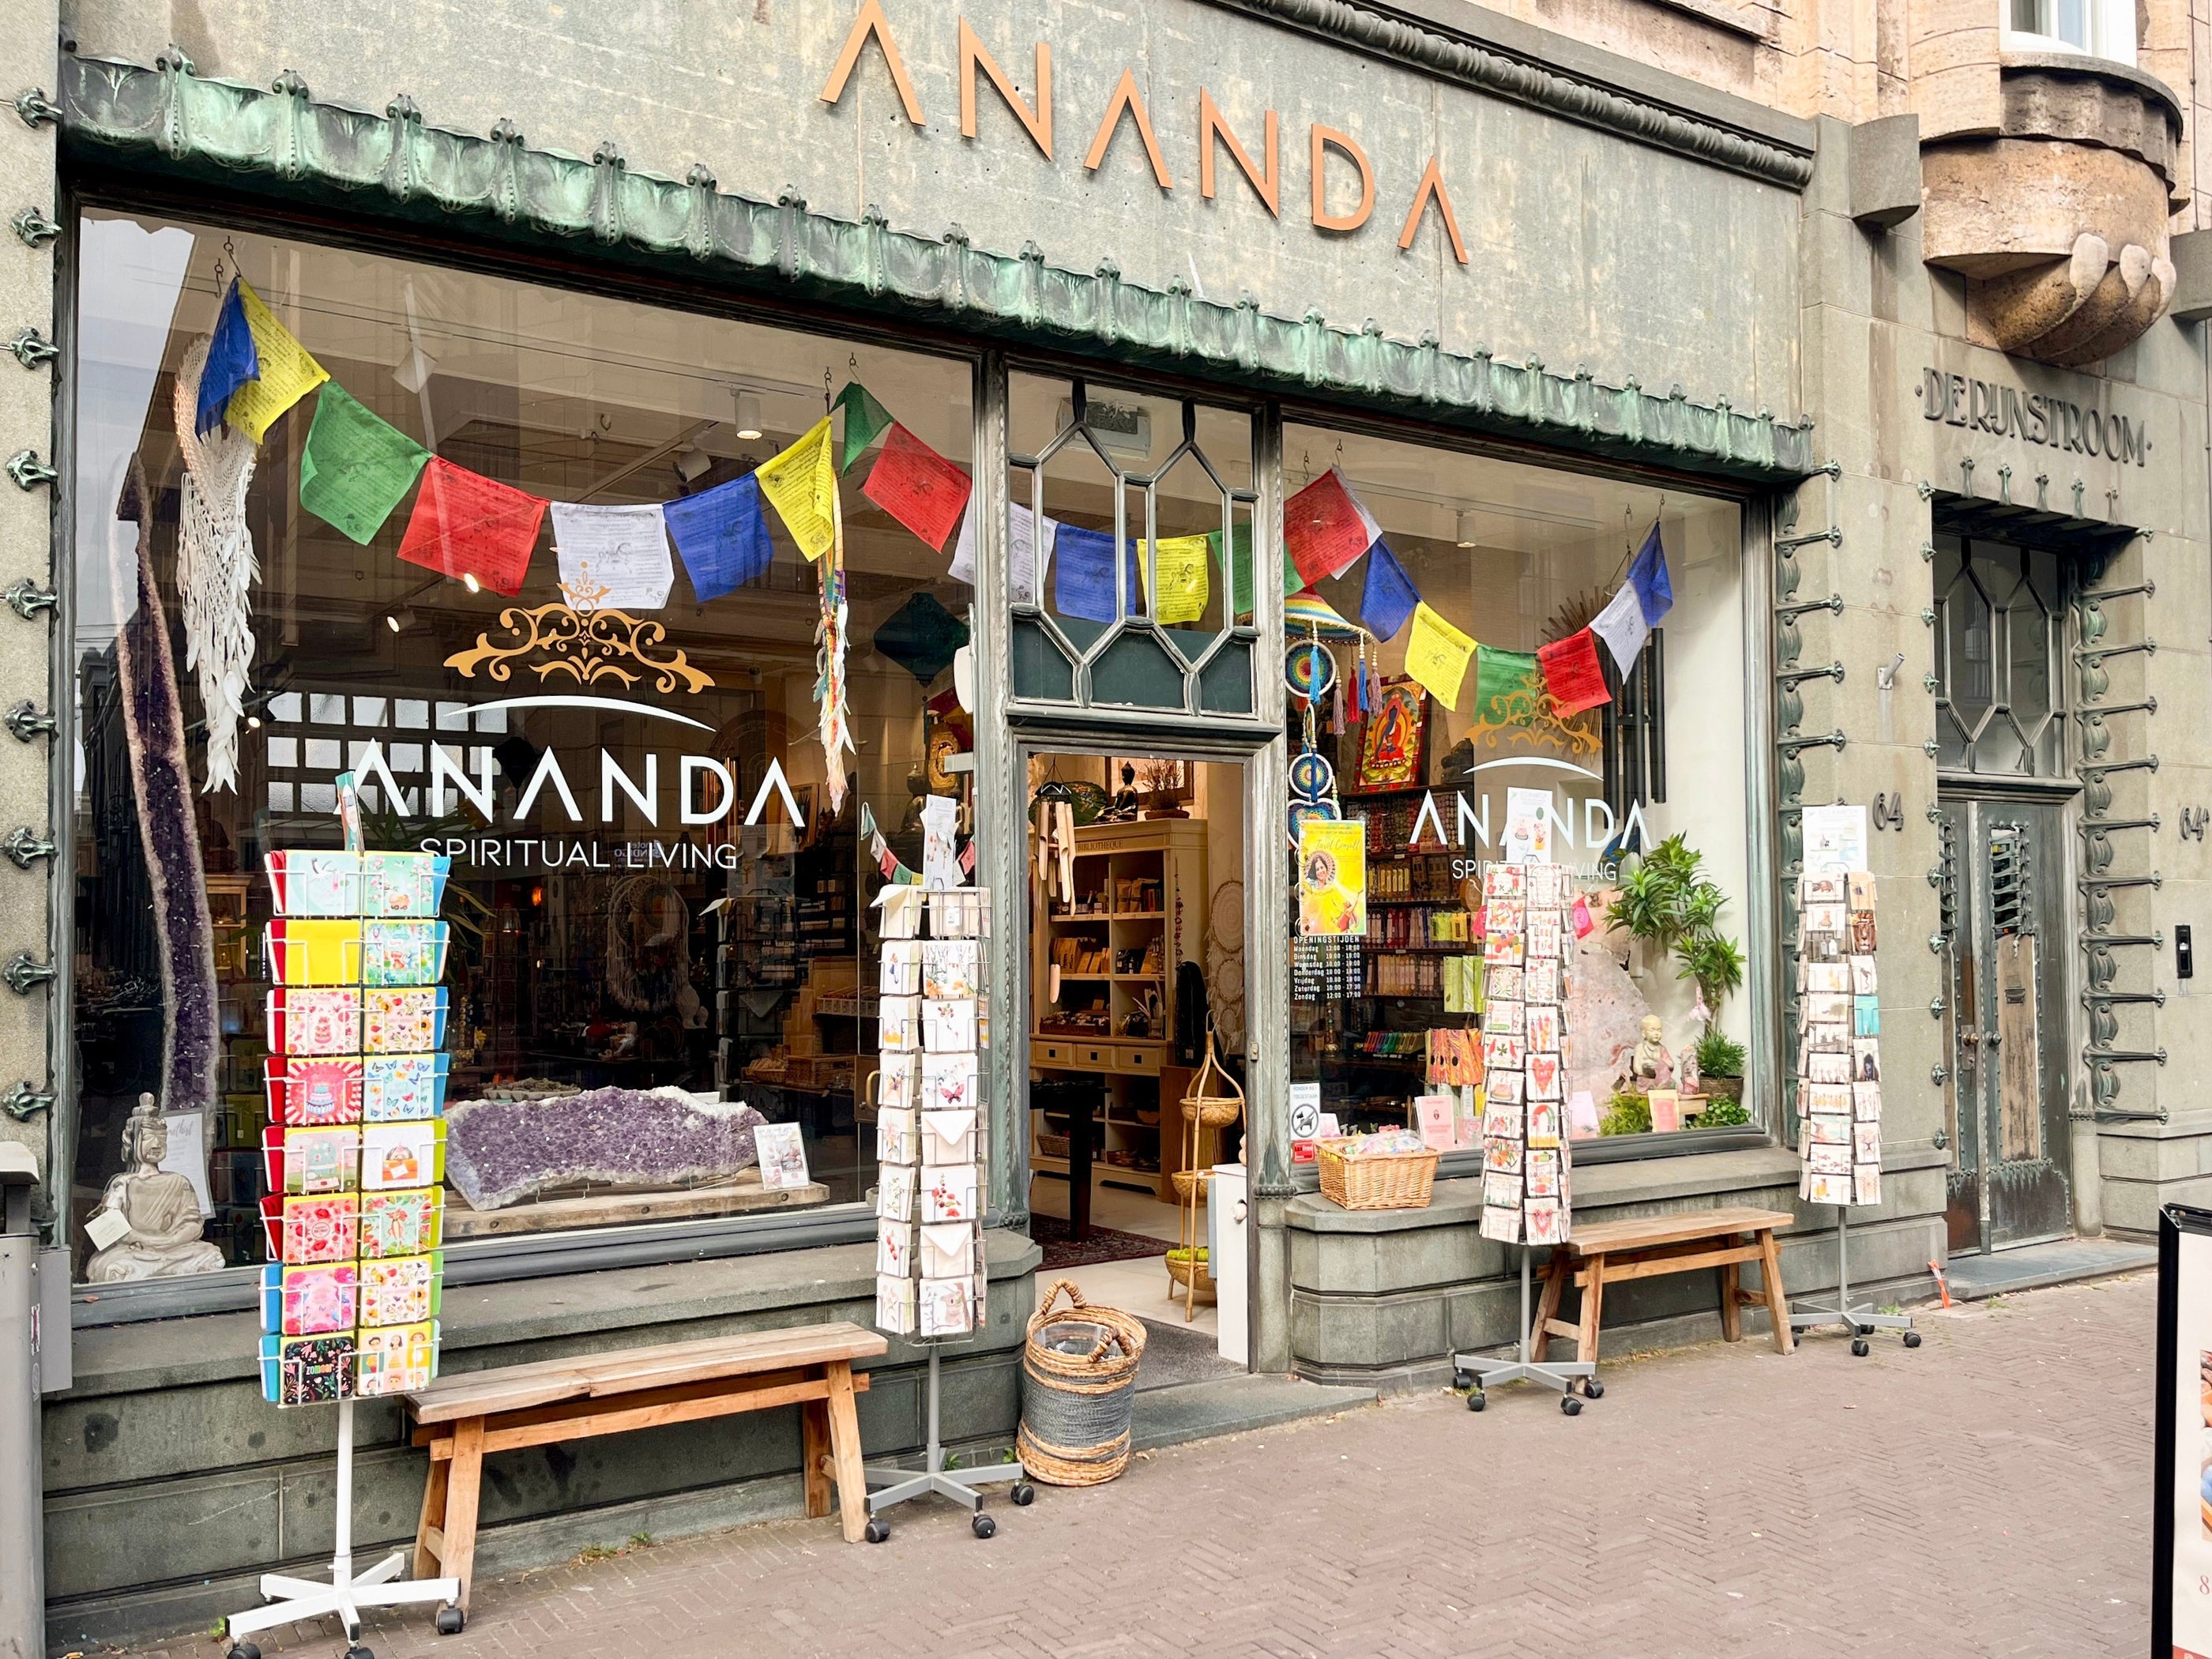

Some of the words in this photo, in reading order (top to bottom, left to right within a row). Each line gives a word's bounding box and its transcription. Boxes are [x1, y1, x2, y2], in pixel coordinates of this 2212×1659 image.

[819, 0, 1469, 265] ANANDA
[333, 737, 806, 827] ANANDA
[1409, 788, 1653, 850] ANNDA
[1872, 792, 1904, 831] 64
[420, 837, 611, 868] SPIRITUAL
[627, 842, 737, 870] LIVING
[1570, 861, 1616, 881] VING
[1293, 935, 1360, 944] OPENINGSTIJDEN
[1293, 976, 1315, 985] Vrijdag
